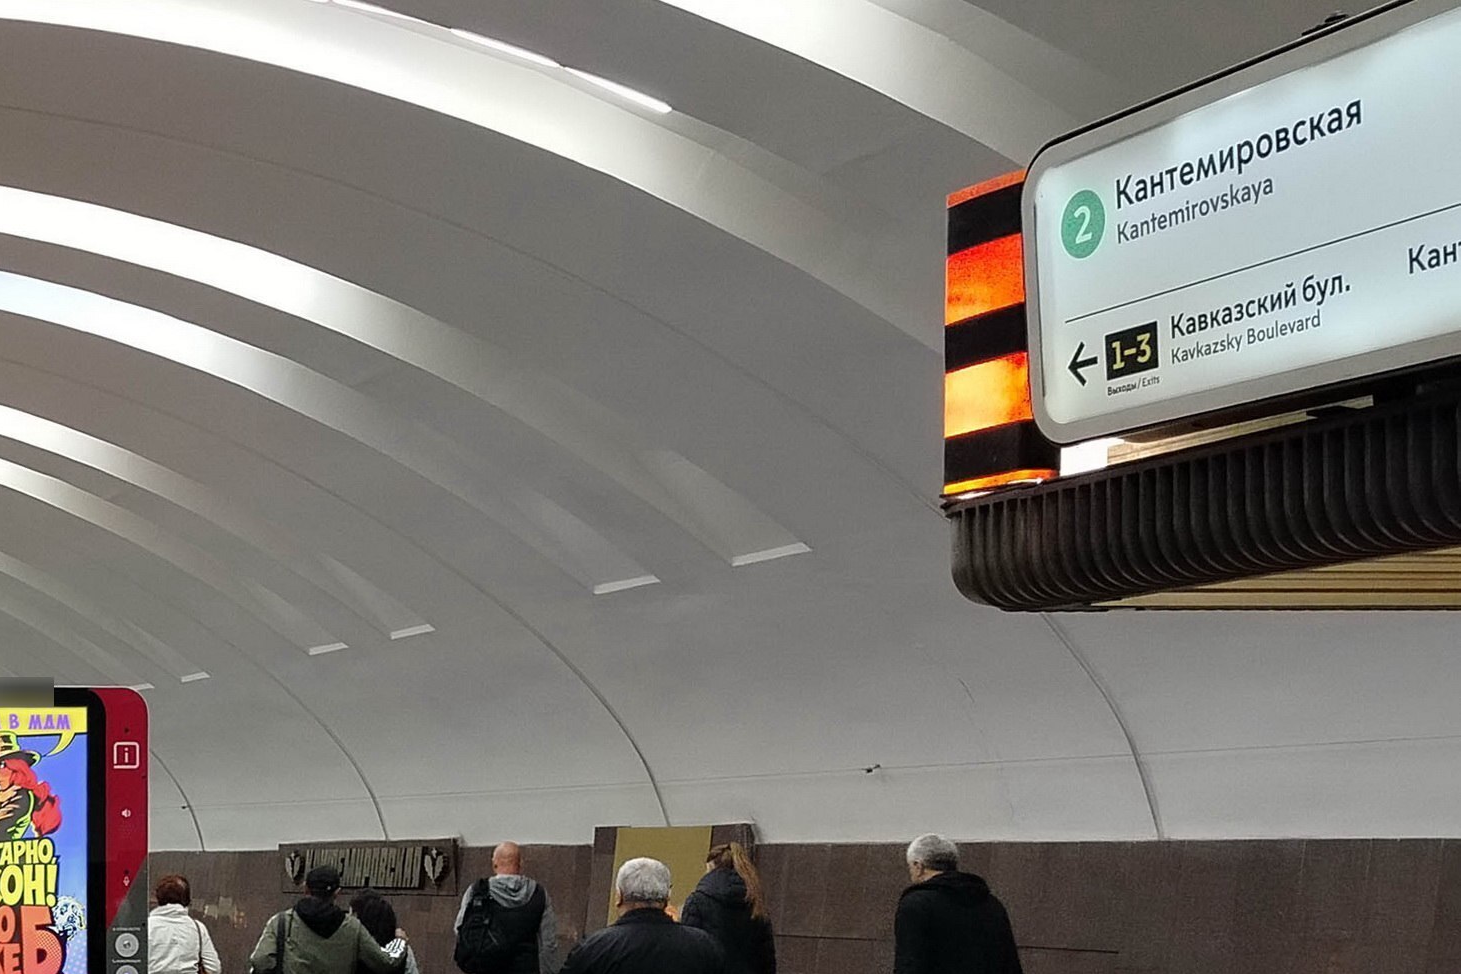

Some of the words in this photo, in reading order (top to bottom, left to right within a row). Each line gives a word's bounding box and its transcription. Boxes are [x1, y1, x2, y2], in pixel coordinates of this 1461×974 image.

[1115, 99, 1363, 209] Кантемировская
[1073, 205, 1093, 244] 2
[1116, 178, 1274, 244] Kantemirovskaya
[1408, 241, 1461, 274] Кан
[1170, 282, 1297, 338] Кавказский
[1301, 273, 1351, 306] бул.
[1111, 333, 1153, 371] 1-3
[1170, 330, 1243, 365] Kavkazsky
[1247, 309, 1321, 345] Boulevard
[9, 713, 20, 730] В
[28, 713, 71, 730] МДМ
